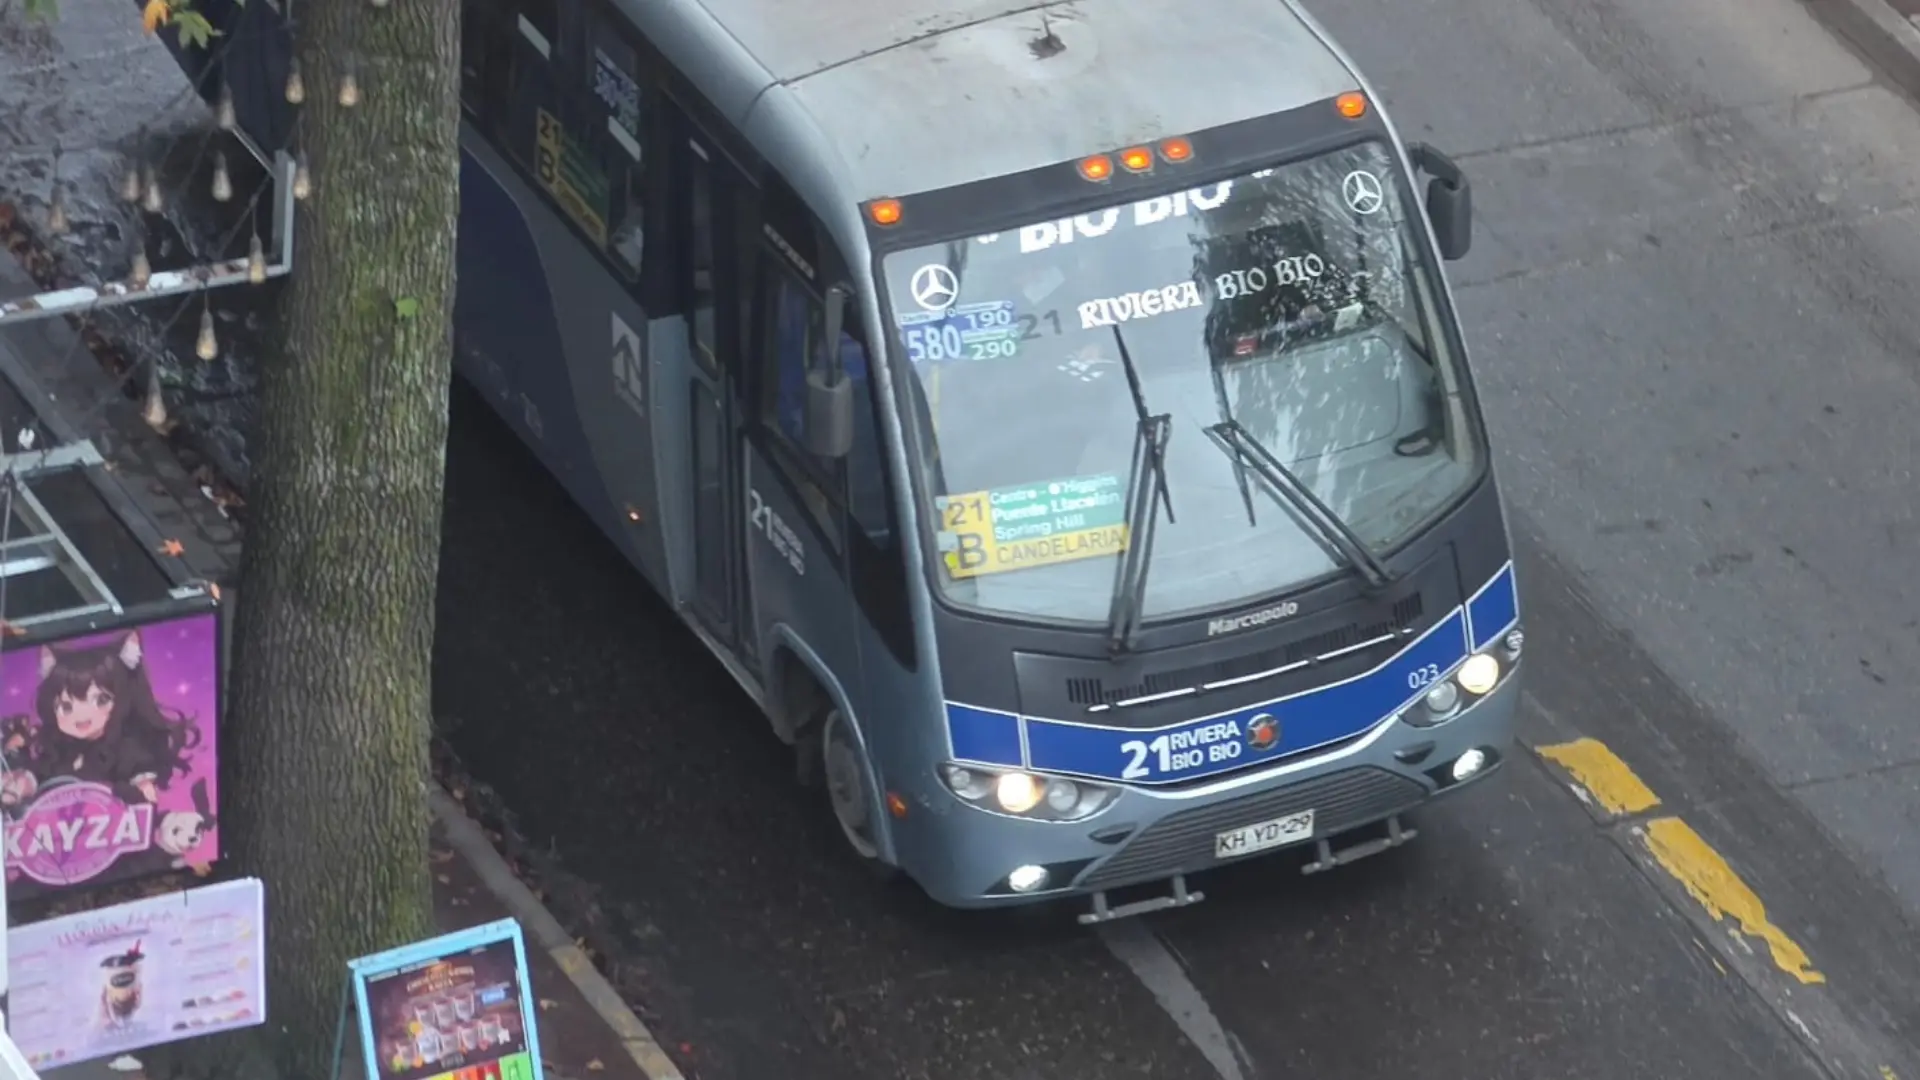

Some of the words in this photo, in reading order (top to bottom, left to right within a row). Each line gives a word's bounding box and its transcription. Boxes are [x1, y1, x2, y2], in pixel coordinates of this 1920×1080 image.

[540, 114, 560, 146] 21
[539, 145, 555, 185] B
[1077, 281, 1203, 329] RIVIERA
[1215, 267, 1268, 300] BIO
[1273, 253, 1325, 286] BIO
[966, 308, 1012, 330] 190
[1018, 310, 1063, 341] 21
[907, 324, 962, 362] 580
[970, 340, 1017, 361] 290
[751, 488, 772, 541] 21
[948, 498, 985, 527] 21
[994, 521, 1052, 541] Spring
[1055, 513, 1086, 530] Hill
[957, 532, 988, 570] B
[998, 528, 1126, 565] CANDELARIA
[1208, 601, 1299, 636] Marcopolo
[1408, 663, 1440, 689] 023
[1171, 720, 1242, 750] RIVIERA
[1120, 735, 1171, 780] 21
[1172, 749, 1204, 771] BIO
[1209, 741, 1242, 762] BIO
[5, 811, 140, 859] KAYZA
[1219, 831, 1247, 852] KH
